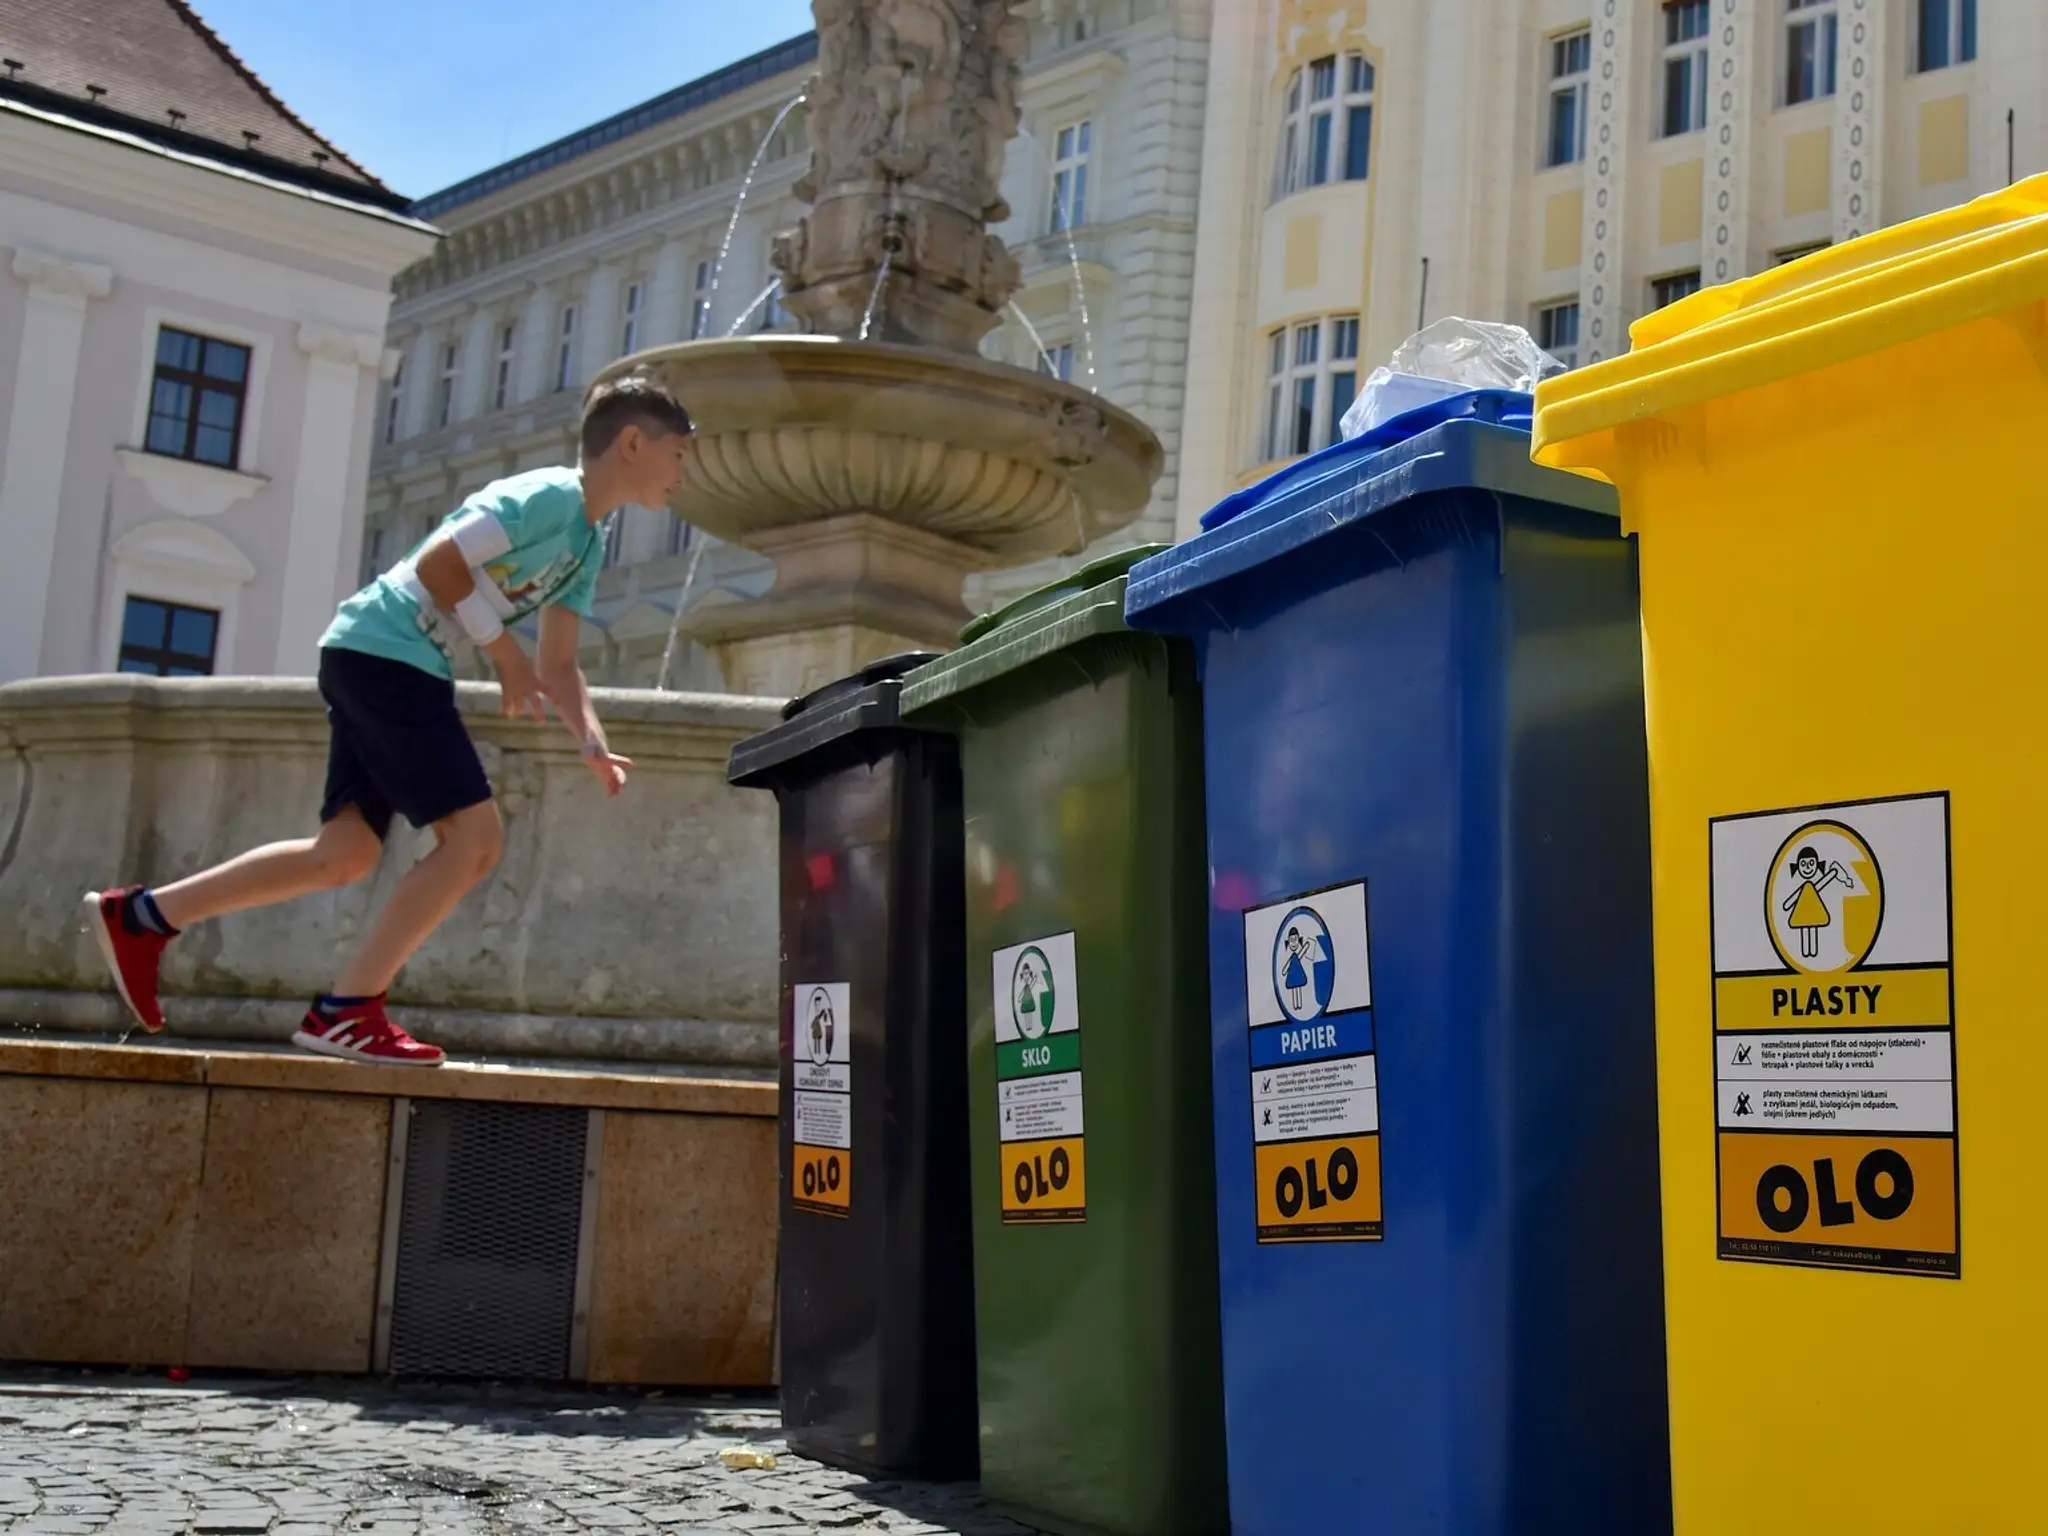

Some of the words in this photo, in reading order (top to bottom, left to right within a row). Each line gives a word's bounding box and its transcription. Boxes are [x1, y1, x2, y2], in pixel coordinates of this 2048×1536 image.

[1772, 984, 1882, 1016] PLASTY
[1281, 1024, 1337, 1054] PAPIER
[1802, 1039, 1829, 1050] plastové
[1848, 1039, 1858, 1047] od
[1859, 1039, 1887, 1050] nápojov
[1022, 1045, 1051, 1068] SKLO
[1761, 1060, 1789, 1070] tetrapak
[1795, 1060, 1823, 1070] plastové
[1825, 1060, 1844, 1070] tašky
[1851, 1060, 1874, 1069] vrecká
[1782, 1050, 1810, 1060] plastové
[1811, 1050, 1831, 1060] obaly
[1837, 1050, 1878, 1059] domácnosti
[1763, 1090, 1782, 1099] plasty
[1819, 1089, 1859, 1100] chemickými
[1861, 1089, 1888, 1098] látkami
[1862, 1100, 1899, 1110] odpadom,
[1784, 1110, 1807, 1119] (okrem
[1809, 1110, 1836, 1119] jedlých)
[803, 1155, 840, 1196] OLO
[1015, 1146, 1069, 1204] OLO
[1276, 1147, 1358, 1218] OLO
[1756, 1148, 1914, 1233] OLO
